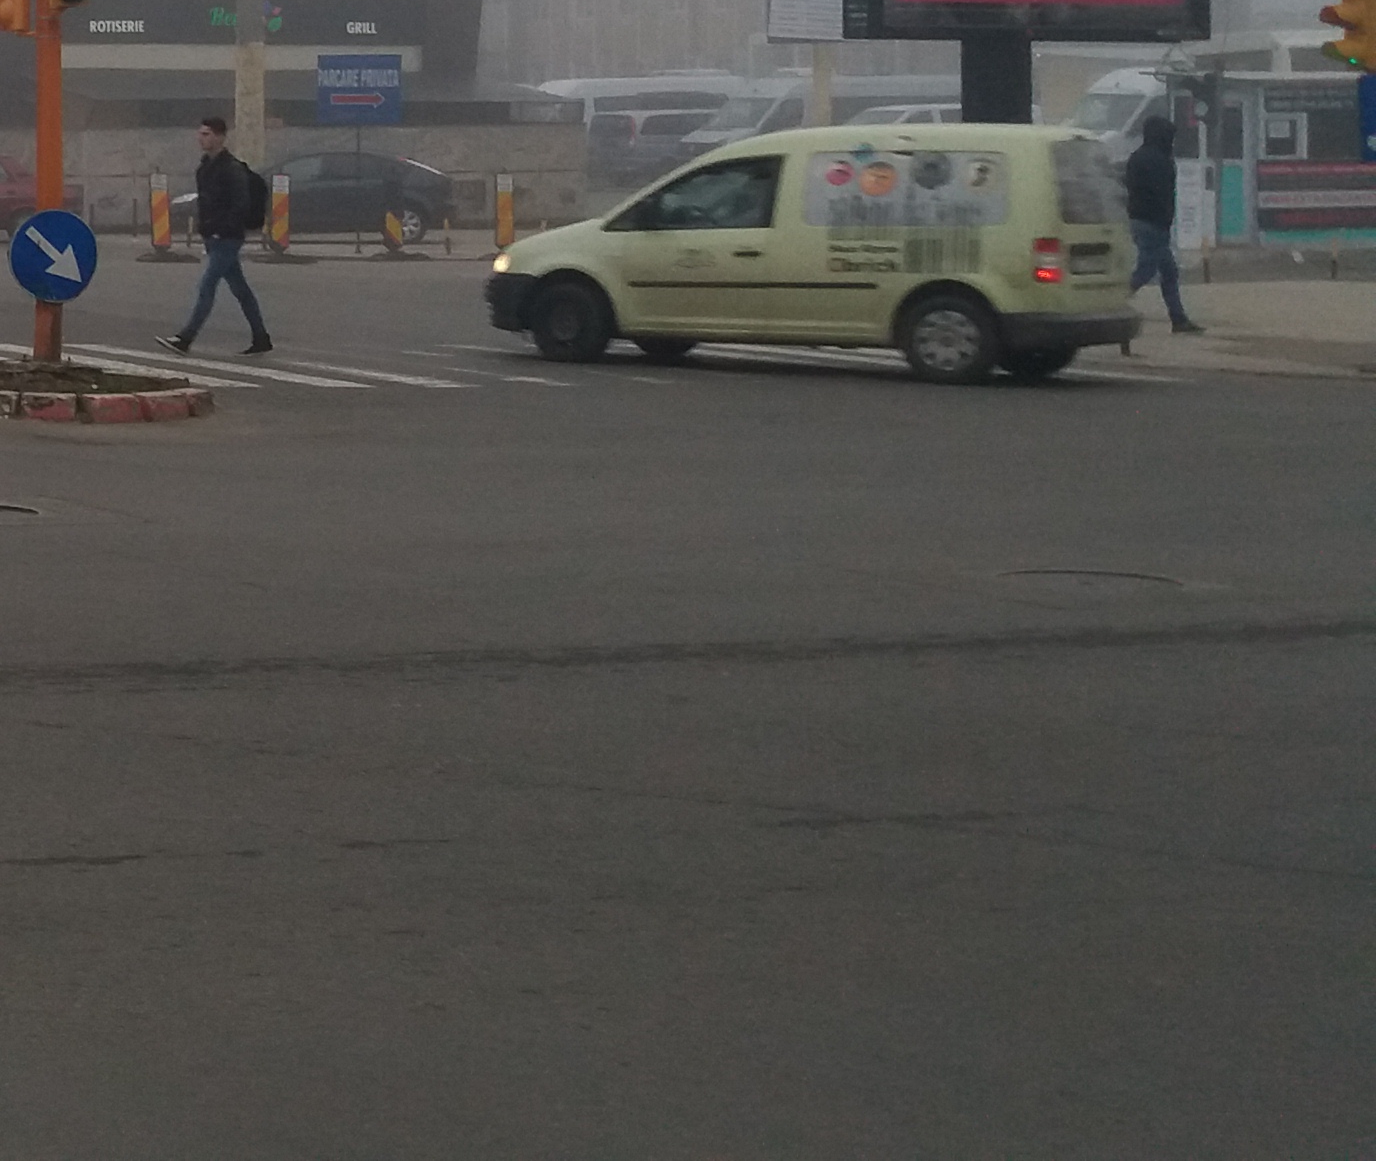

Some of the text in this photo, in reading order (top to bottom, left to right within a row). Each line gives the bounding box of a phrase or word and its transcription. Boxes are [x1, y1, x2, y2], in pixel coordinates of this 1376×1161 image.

[89, 20, 145, 33] ROTISERIE
[346, 21, 378, 34] GRILL
[318, 69, 359, 87] PARCARE
